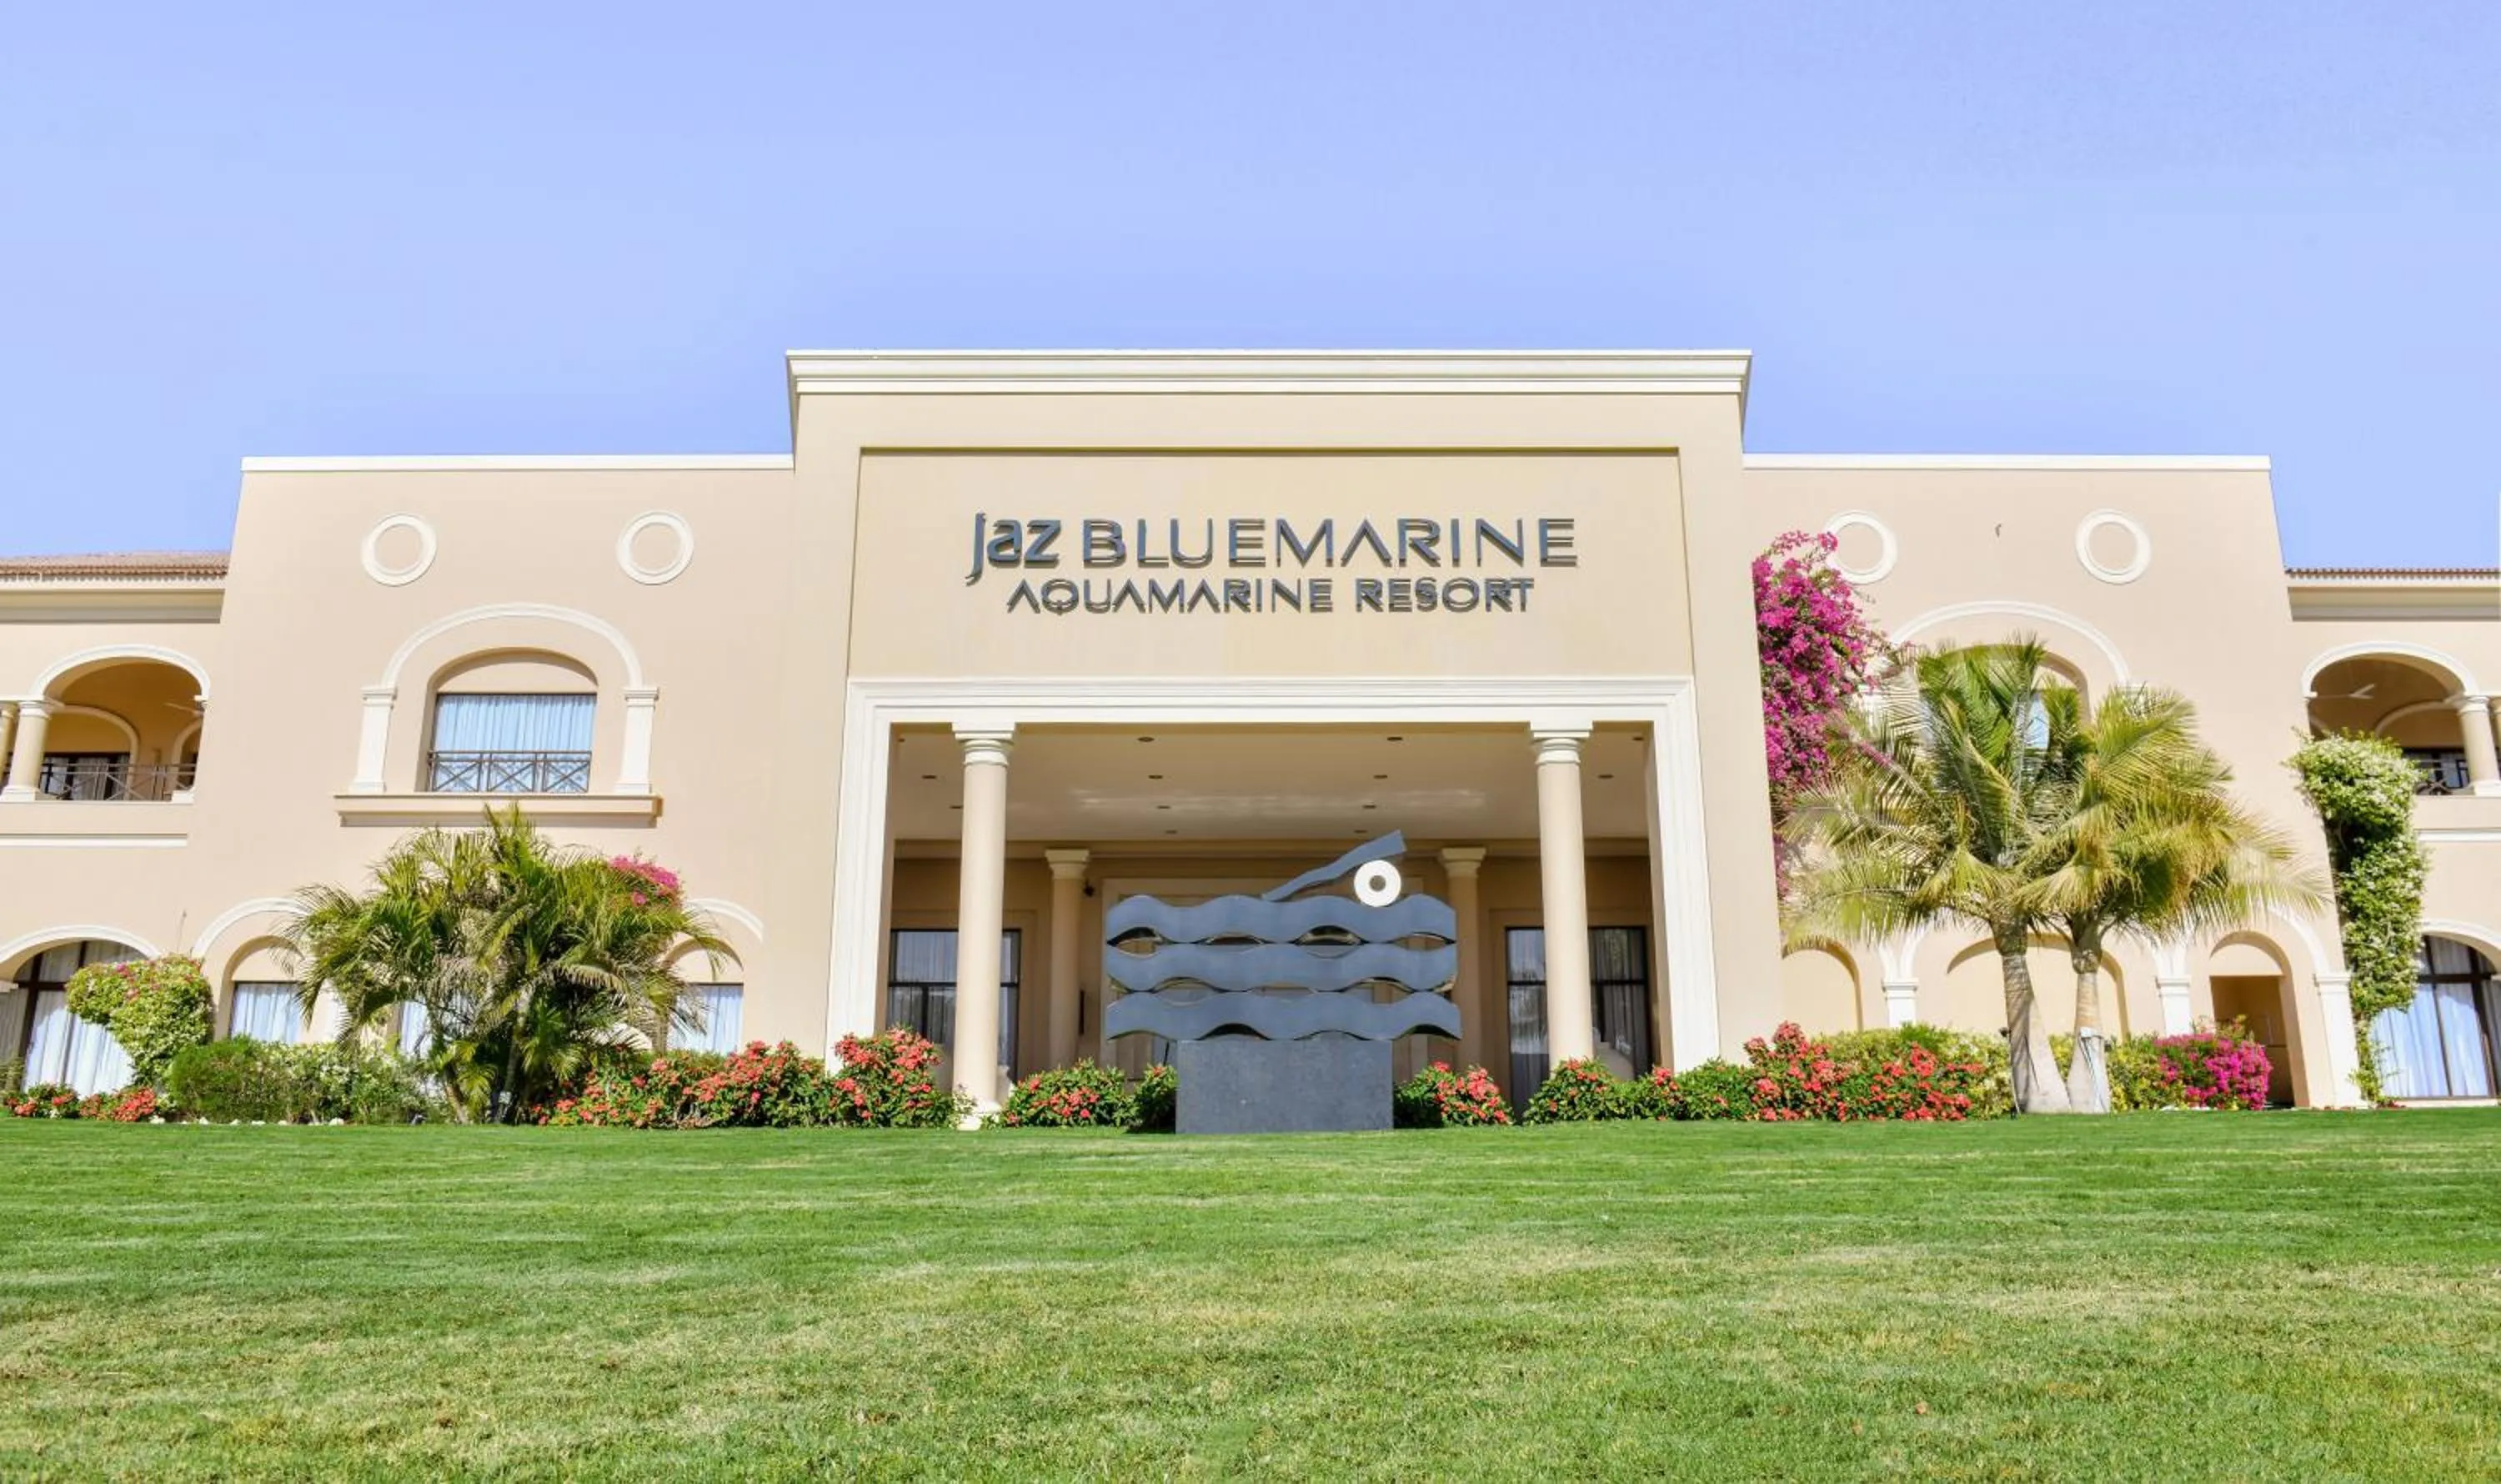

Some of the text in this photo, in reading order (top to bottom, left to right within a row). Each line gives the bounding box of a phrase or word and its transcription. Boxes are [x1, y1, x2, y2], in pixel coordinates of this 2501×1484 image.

[1083, 518, 1578, 569] BLUEMARINE
[1006, 577, 1535, 615] AQUAMARINE RESORT
